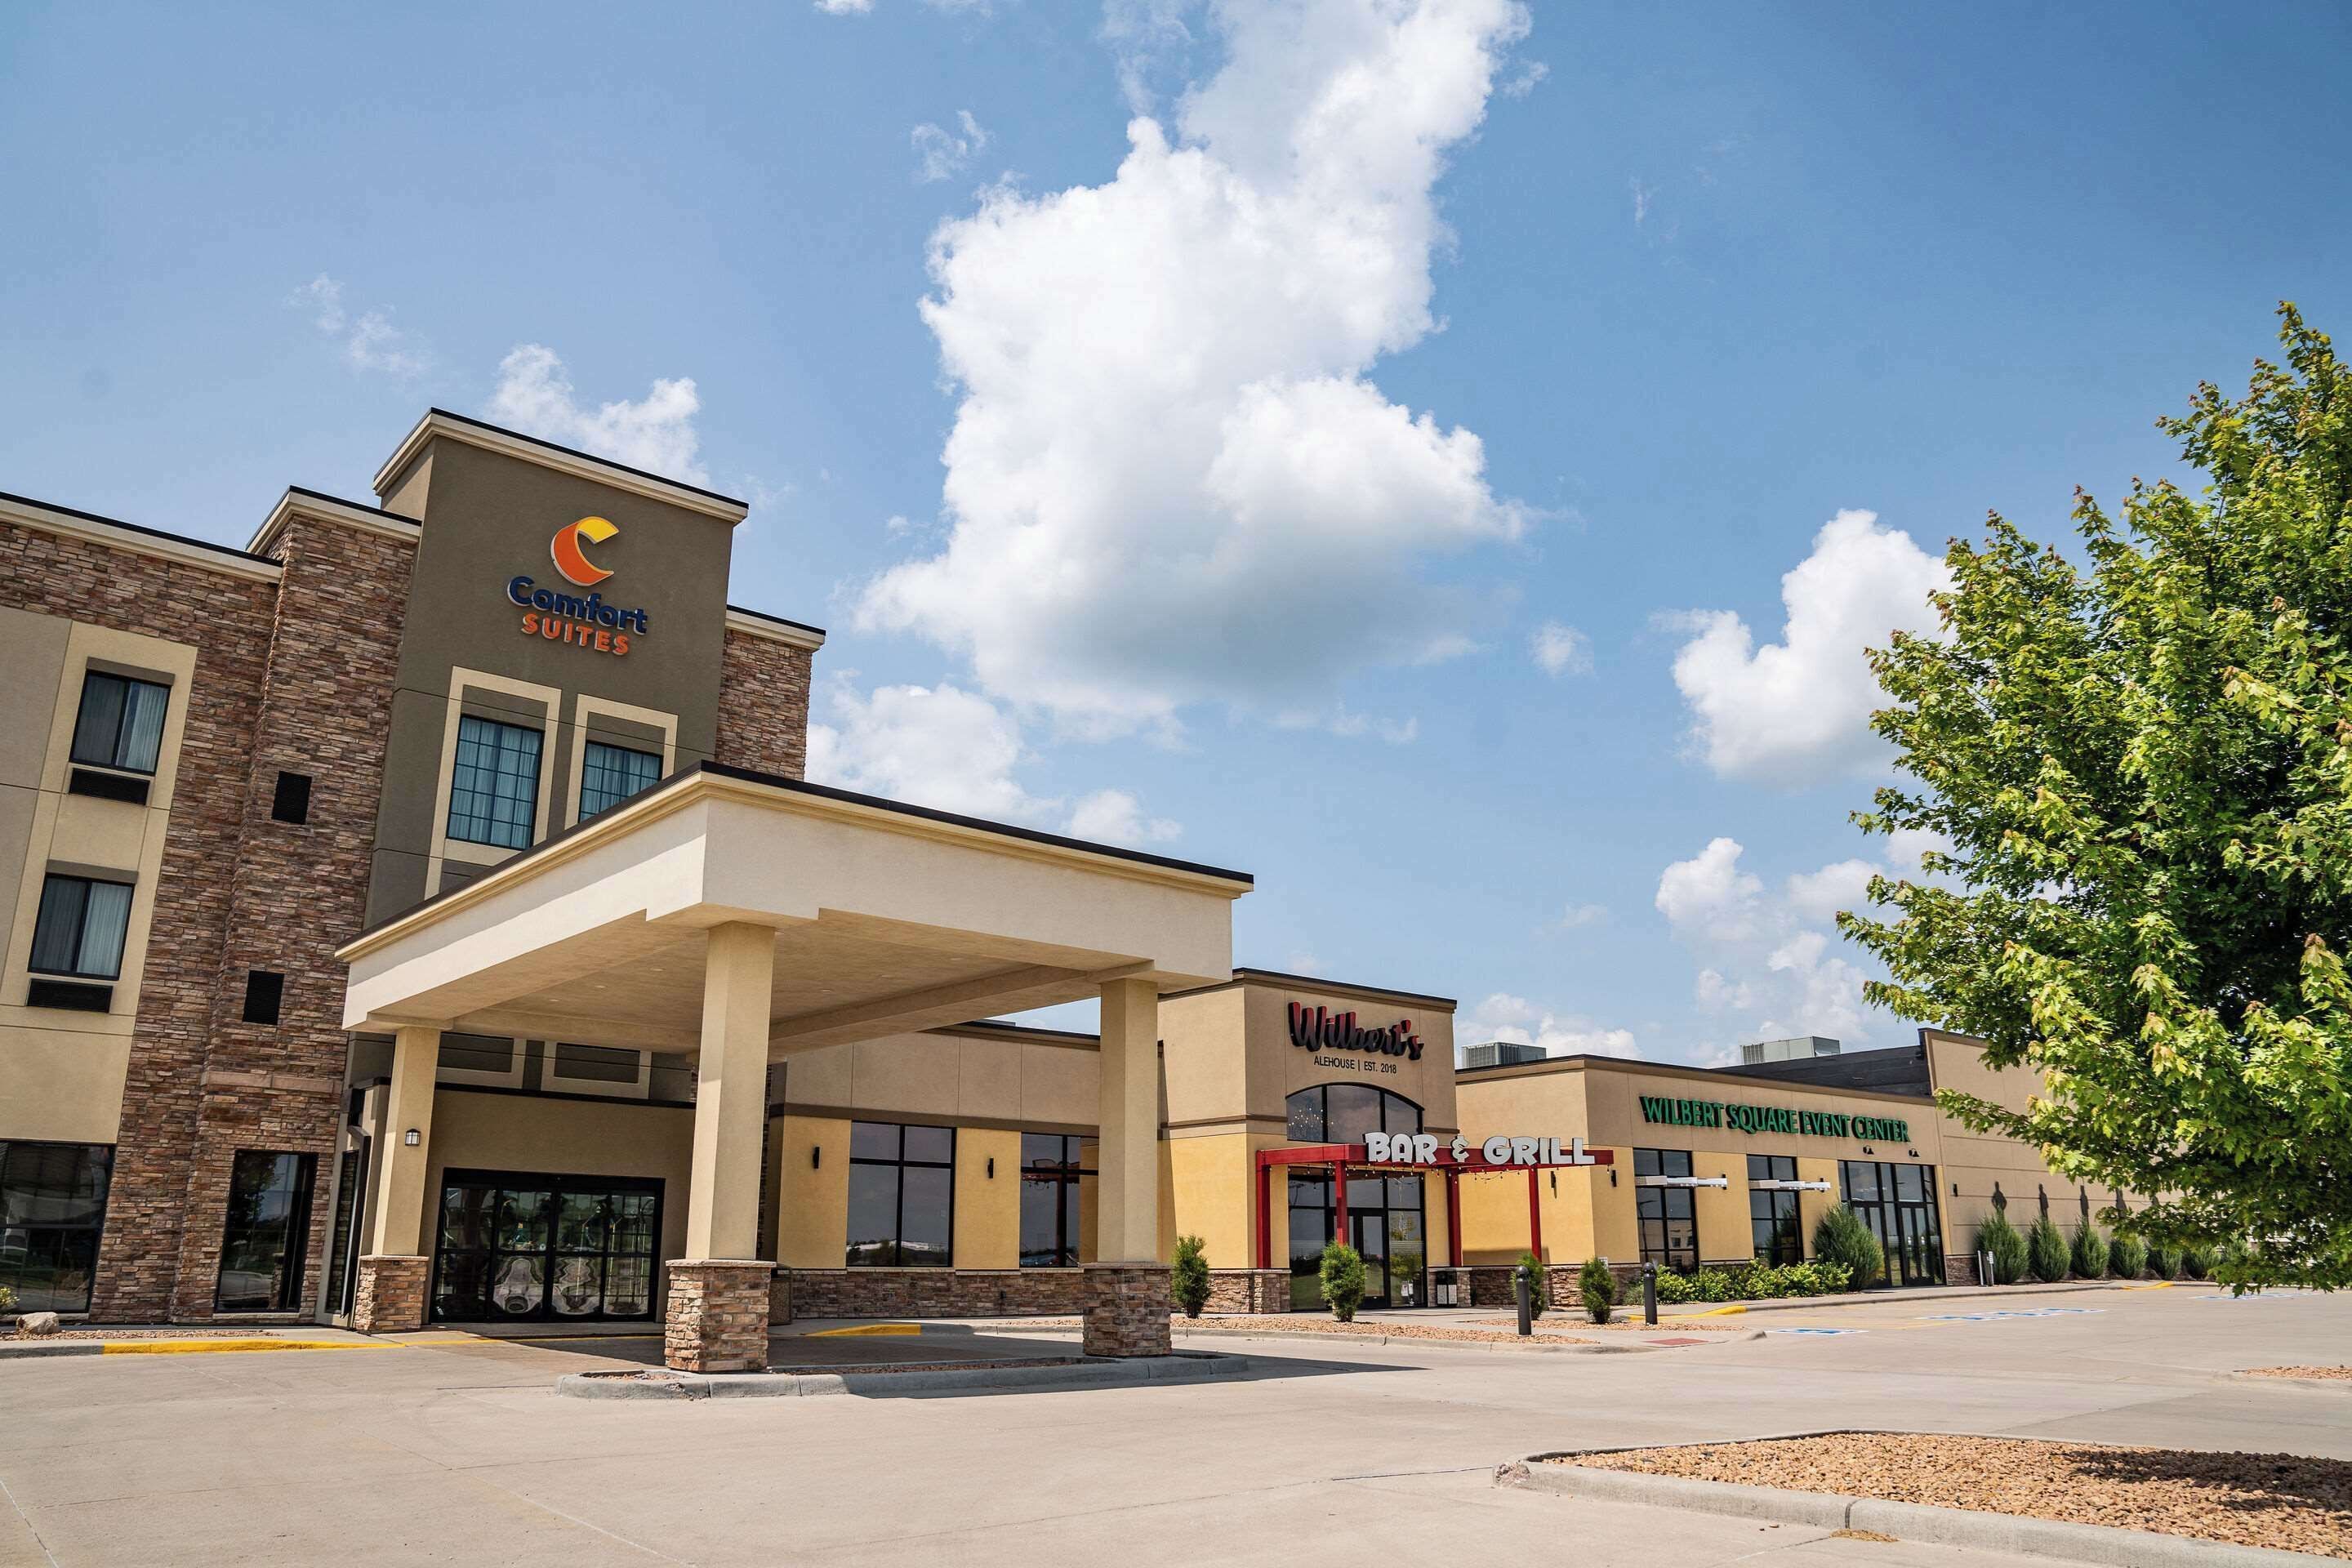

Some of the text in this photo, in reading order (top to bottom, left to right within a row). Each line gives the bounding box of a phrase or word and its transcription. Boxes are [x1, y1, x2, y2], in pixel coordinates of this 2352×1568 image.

[506, 576, 648, 635] Comfort
[521, 613, 630, 656] SUITES
[1288, 1001, 1425, 1060] Wilbert's
[1313, 1055, 1356, 1070] ALEHOUSE
[1364, 1061, 1378, 1072] EST.
[1380, 1063, 1397, 1074] 2018
[1639, 1096, 1911, 1143] WILBERT SQUARE EVENT CENTER
[1362, 1131, 1596, 1165] BAR & GRILL
